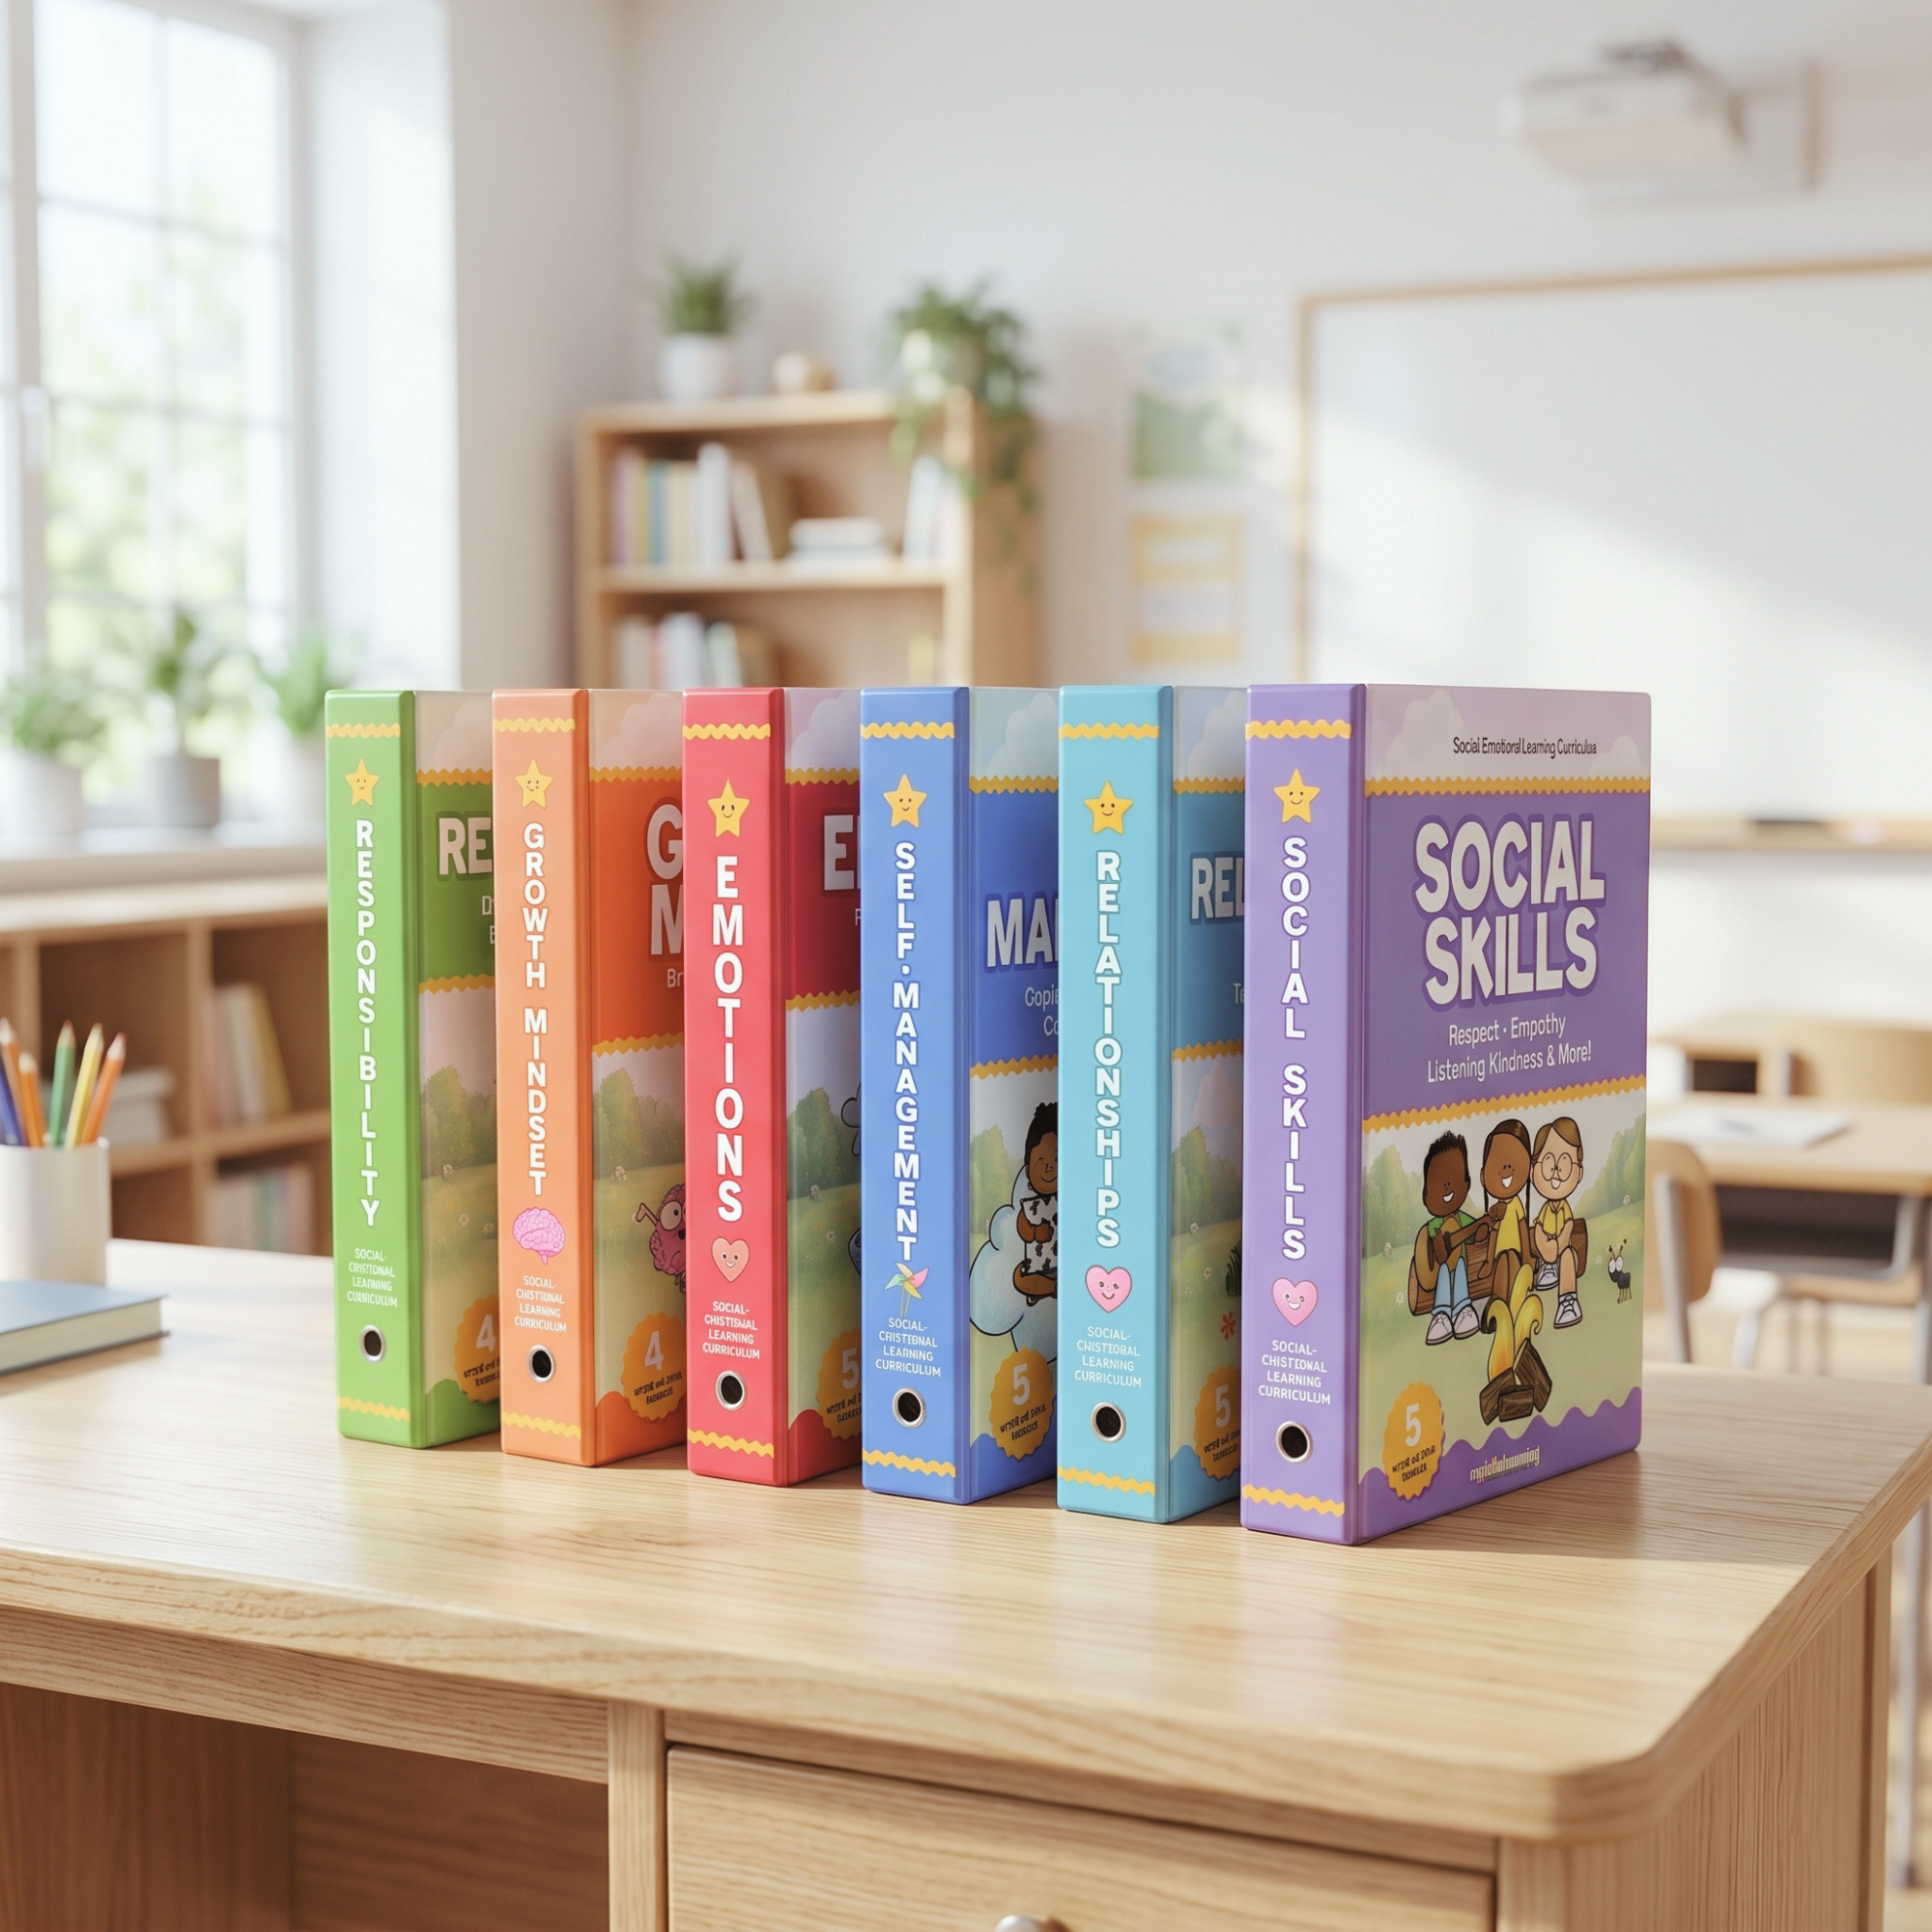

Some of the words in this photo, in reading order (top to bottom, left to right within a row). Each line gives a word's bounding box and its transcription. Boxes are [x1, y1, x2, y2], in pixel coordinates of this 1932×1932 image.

[1415, 820, 1605, 914] SOCIAL
[522, 823, 549, 988] GROWTH
[1281, 836, 1310, 1038] SOCIAL
[1425, 906, 1597, 1005] SKILLS
[355, 819, 380, 1227] RESPONSIBILITY
[713, 856, 744, 1222] EMOTIONS
[1449, 1020, 1499, 1049] Respect
[1094, 851, 1122, 1248] RELATIONSHIPS
[1427, 1057, 1486, 1083] Listening
[1490, 1049, 1544, 1074] Kindness
[1547, 1044, 1556, 1066] &
[1558, 1039, 1592, 1065] More!
[525, 1008, 548, 1196] MINDSET
[1282, 1064, 1307, 1260] SKILLS
[514, 1316, 567, 1333] CURRICULUM
[520, 1303, 561, 1318] LEARNING
[712, 1300, 750, 1315] SOCIAL-
[888, 1317, 928, 1332] SOCIAL-
[475, 1314, 497, 1352] 4
[644, 1330, 665, 1371] 4
[702, 1342, 760, 1360] CURRICULUM
[708, 1328, 754, 1345] LEARNING
[1087, 1325, 1131, 1341] SOCIAL-
[1271, 1339, 1318, 1355] SOCIAL-
[842, 1347, 861, 1389] 5
[875, 1358, 941, 1378] CURRICULUM
[883, 1345, 934, 1362] LEARNING
[1082, 1354, 1135, 1372] LEARNING
[1012, 1362, 1031, 1406] 5
[1074, 1369, 1142, 1388] CURRICULUM
[1258, 1384, 1331, 1405] CURRICULUM
[1266, 1370, 1321, 1388] LEARNING
[1215, 1383, 1232, 1428] 5
[1405, 1403, 1422, 1447] 5
